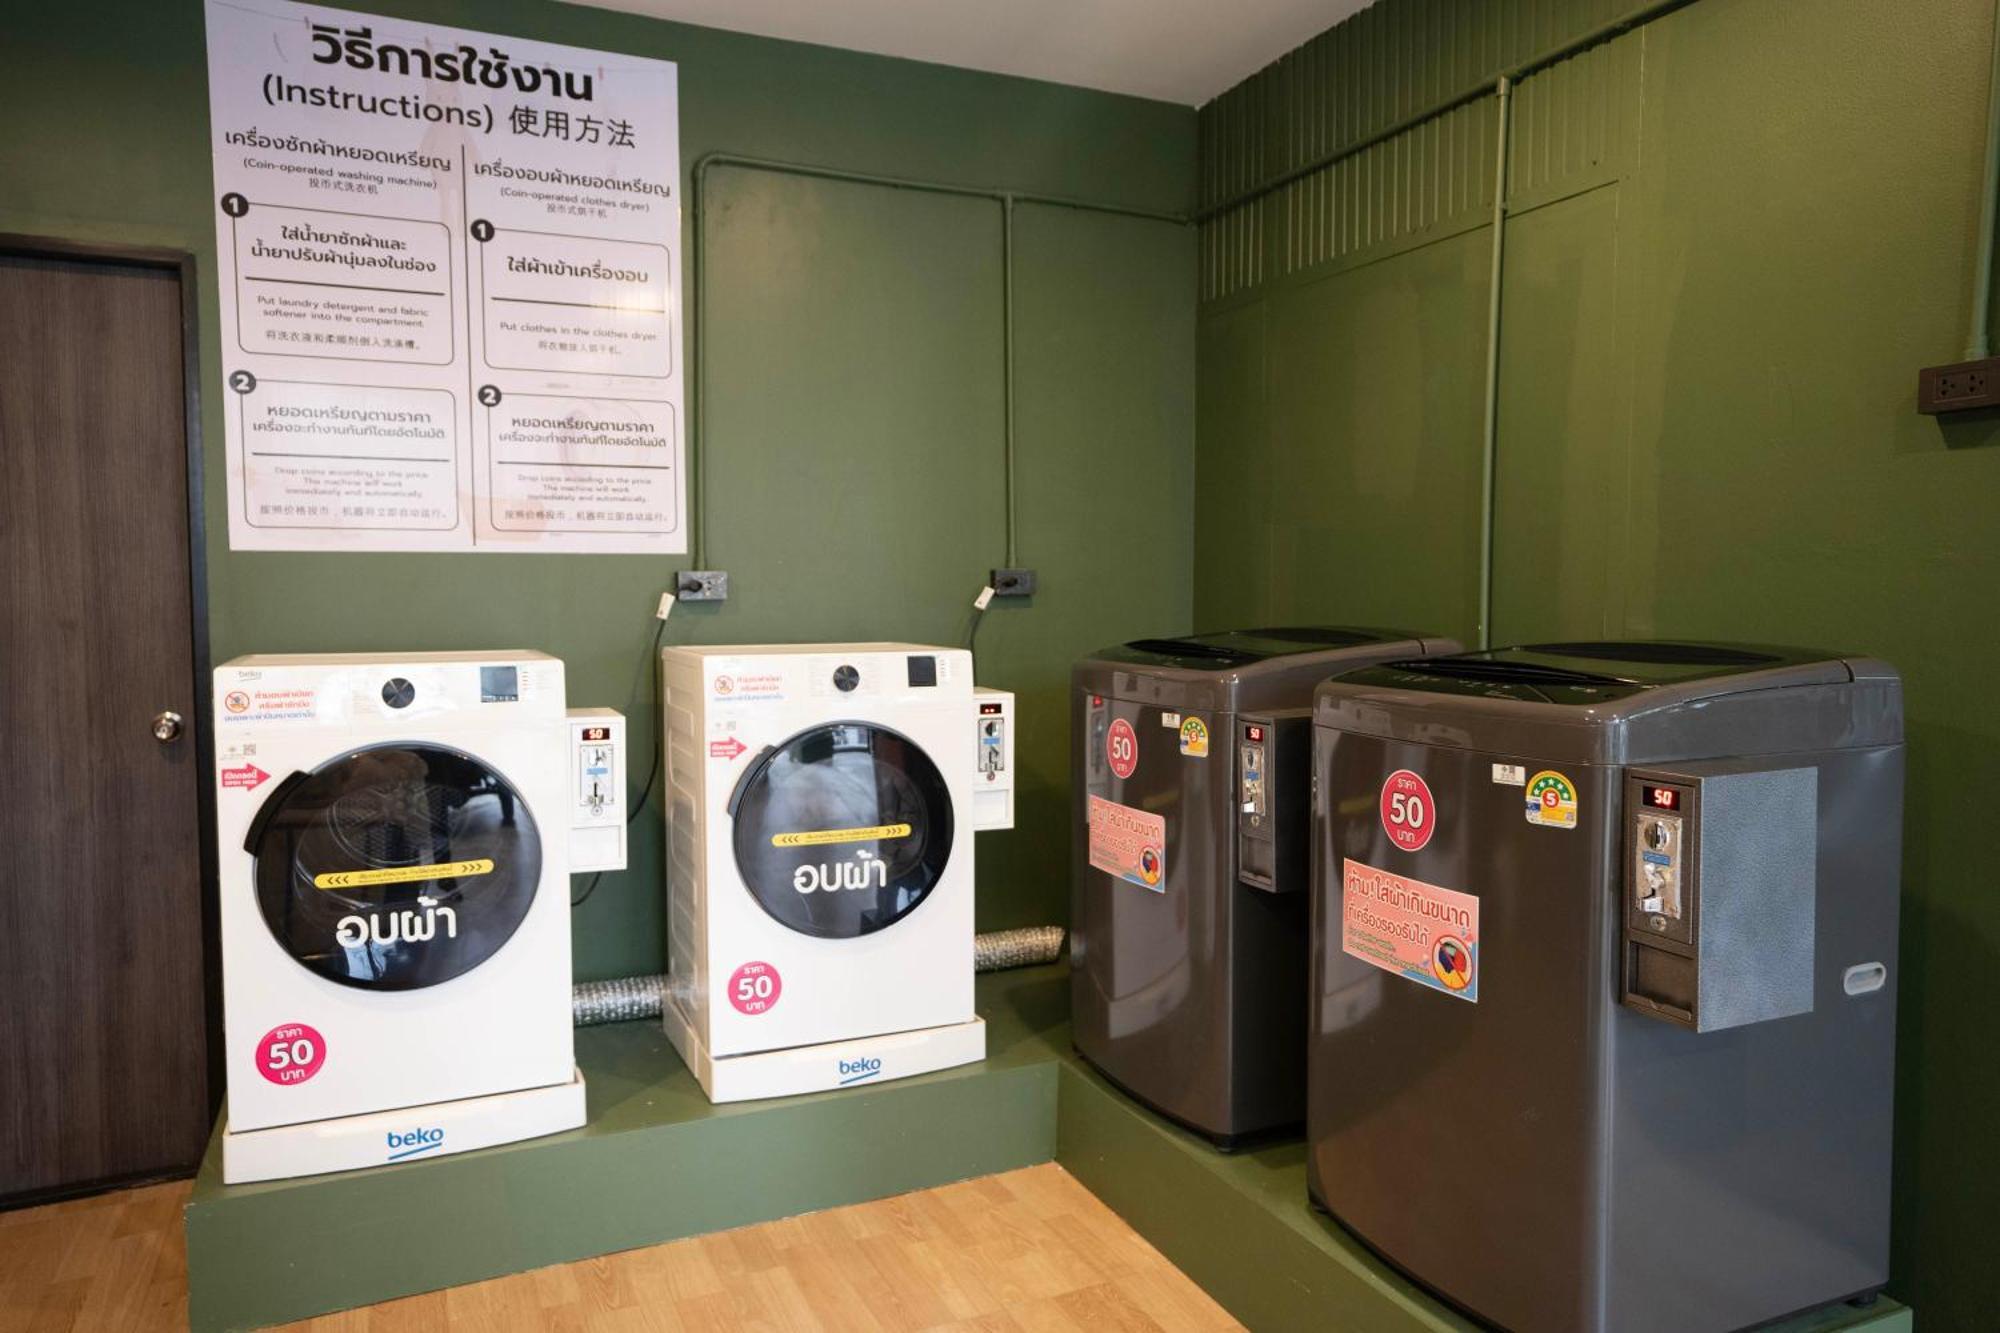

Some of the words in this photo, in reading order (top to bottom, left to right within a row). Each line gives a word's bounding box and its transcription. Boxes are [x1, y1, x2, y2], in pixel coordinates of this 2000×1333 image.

[311, 24, 593, 101] วิธีการใช้งาน
[262, 73, 494, 133] (Instructions)
[508, 104, 636, 149] 使用方法
[225, 126, 452, 171] เครื่องซักผ้าหยอดเหรียญ
[243, 158, 334, 178] (Coin-operated
[338, 169, 384, 184] washing
[387, 176, 438, 189] machine)
[474, 158, 670, 198] เครื่องอบผ้าหยอดเหรียญ
[500, 187, 579, 204] (Coin-operated
[581, 193, 617, 208] clothes
[619, 200, 650, 213] dryer)
[281, 224, 407, 251] ใส่น้ำยาซักผ้าและ
[251, 238, 437, 272] น้ำยาปรับผ้านุ่มลงในช่อง
[507, 256, 649, 283] ใส่ผ้าเข้าเครื่องอบ
[257, 295, 275, 305] Put
[279, 297, 319, 310] laundry
[323, 300, 375, 314] detergent
[378, 304, 398, 314] and
[400, 306, 429, 317] fabric
[263, 308, 307, 318] softener
[311, 312, 332, 321] into
[335, 313, 352, 322] the
[499, 321, 517, 331] Put
[520, 323, 558, 334] clothes
[560, 326, 571, 334] in
[573, 326, 590, 336] the
[593, 328, 628, 339] clothes
[267, 405, 431, 424] หยอดเหรียญตามราคา
[512, 416, 655, 433] หยอดเหรียญตามราคา
[588, 728, 604, 740] 50
[1112, 736, 1131, 761] 50
[1397, 778, 1417, 791] ราคา
[1546, 791, 1556, 807] 5
[1653, 788, 1673, 806] 50
[1390, 792, 1424, 829] 50
[1396, 829, 1416, 843] บาท
[793, 850, 887, 895] อบผ้า
[336, 896, 457, 949] อบผ้า
[744, 966, 764, 976] ราคา
[736, 976, 773, 1000] 50
[745, 1001, 765, 1012] บาท
[276, 1027, 303, 1039] ราคา
[268, 1040, 315, 1070] 50
[839, 1058, 881, 1076] beko
[280, 1069, 305, 1082] บาท
[387, 1127, 444, 1152] beko
